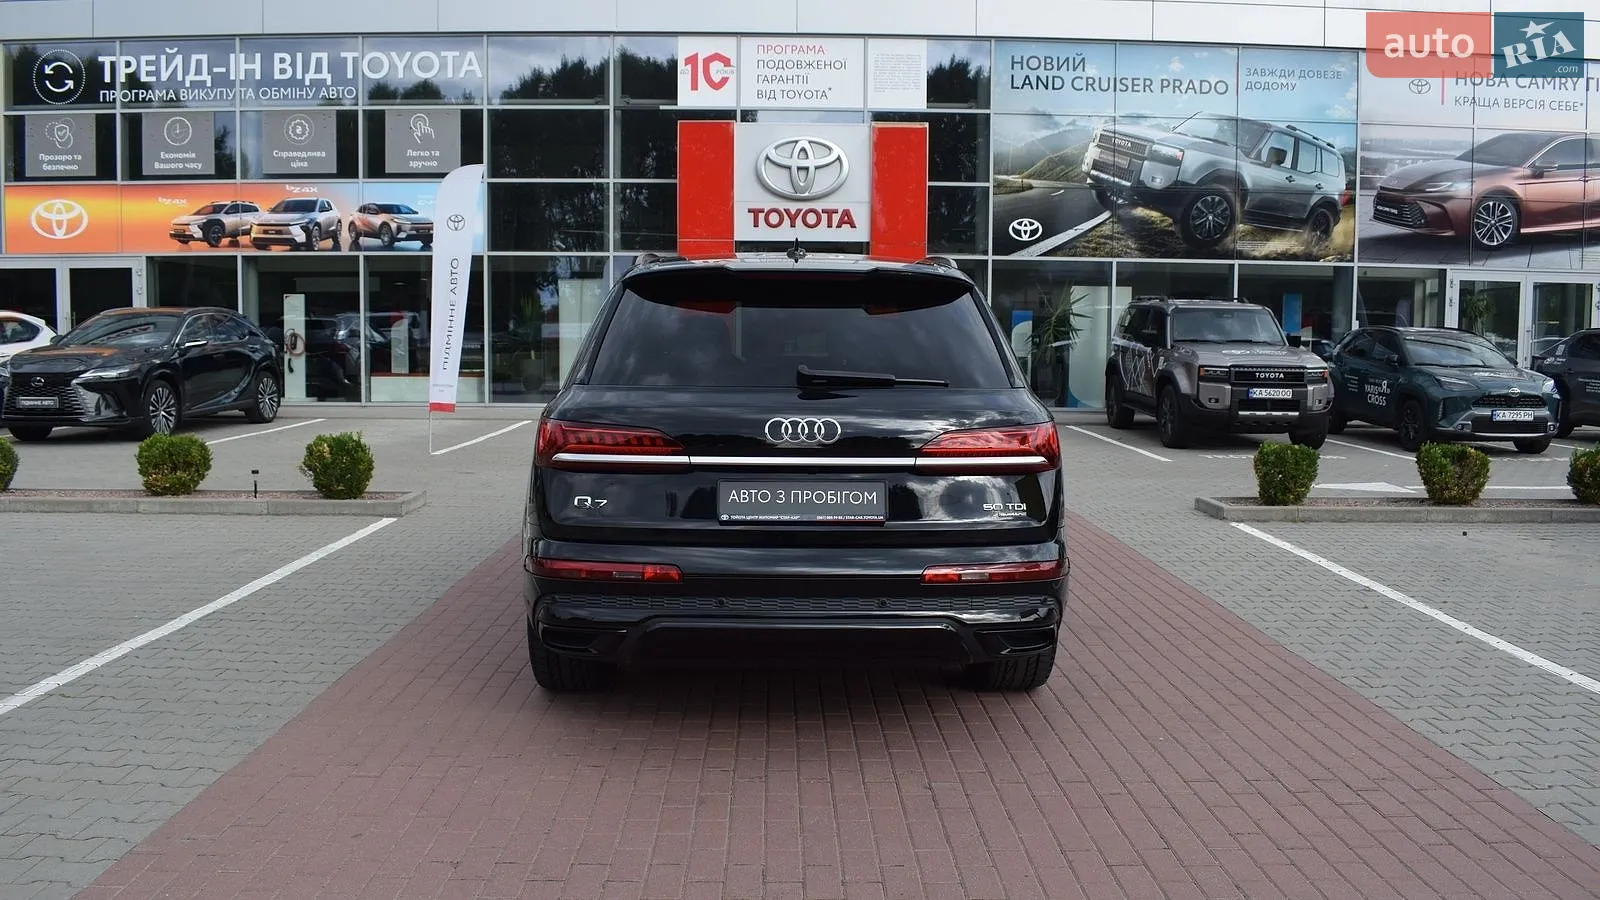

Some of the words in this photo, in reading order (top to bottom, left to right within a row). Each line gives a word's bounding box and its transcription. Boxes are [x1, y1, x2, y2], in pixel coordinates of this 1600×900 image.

[756, 44, 825, 55] ПРОГРАМА
[98, 47, 261, 88] ТРЕЙД-ІН
[273, 52, 332, 86] ВІД
[340, 51, 483, 80] TOYOTA
[756, 57, 848, 72] ПОДОВЖЕНОЇ
[1010, 52, 1086, 72] НОВИЙ
[756, 72, 810, 85] ГАРАНТІЇ
[1245, 67, 1296, 80] ЗАВЖДИ
[1298, 69, 1342, 81] ДОВЕЗЕ
[1010, 74, 1065, 91] LAND
[1070, 75, 1154, 93] CRUISER
[1160, 78, 1229, 95] PRADO
[1245, 80, 1297, 92] ДОДОМУ
[1455, 71, 1509, 88] НОВА
[1515, 74, 1581, 92] CAMRY
[100, 89, 176, 102] ПРОГРАМА
[180, 88, 236, 101] ВИКУПУ
[239, 88, 256, 100] ТА
[258, 87, 318, 100] ОБМІНУ
[319, 86, 357, 99] АВТО
[756, 89, 777, 101] ВІД
[1454, 96, 1500, 109] КРАЩА
[1503, 98, 1545, 110] ВЕРСІЯ
[160, 151, 196, 159] Економія
[273, 150, 326, 159] Справедлива
[406, 149, 431, 157] Легко
[154, 161, 184, 169] Вашого
[184, 162, 203, 170] часу
[290, 159, 308, 168] ціна
[408, 159, 438, 168] зручно
[747, 207, 857, 229] TOYOTA
[450, 258, 460, 296] АВТО
[1367, 394, 1387, 406] CROSS
[574, 496, 608, 508] Q7
[728, 489, 771, 504] АВТО
[776, 490, 786, 504] З
[791, 490, 877, 505] ПРОБІГОМ
[983, 503, 1004, 511] 50
[1006, 503, 1027, 511] TDI
